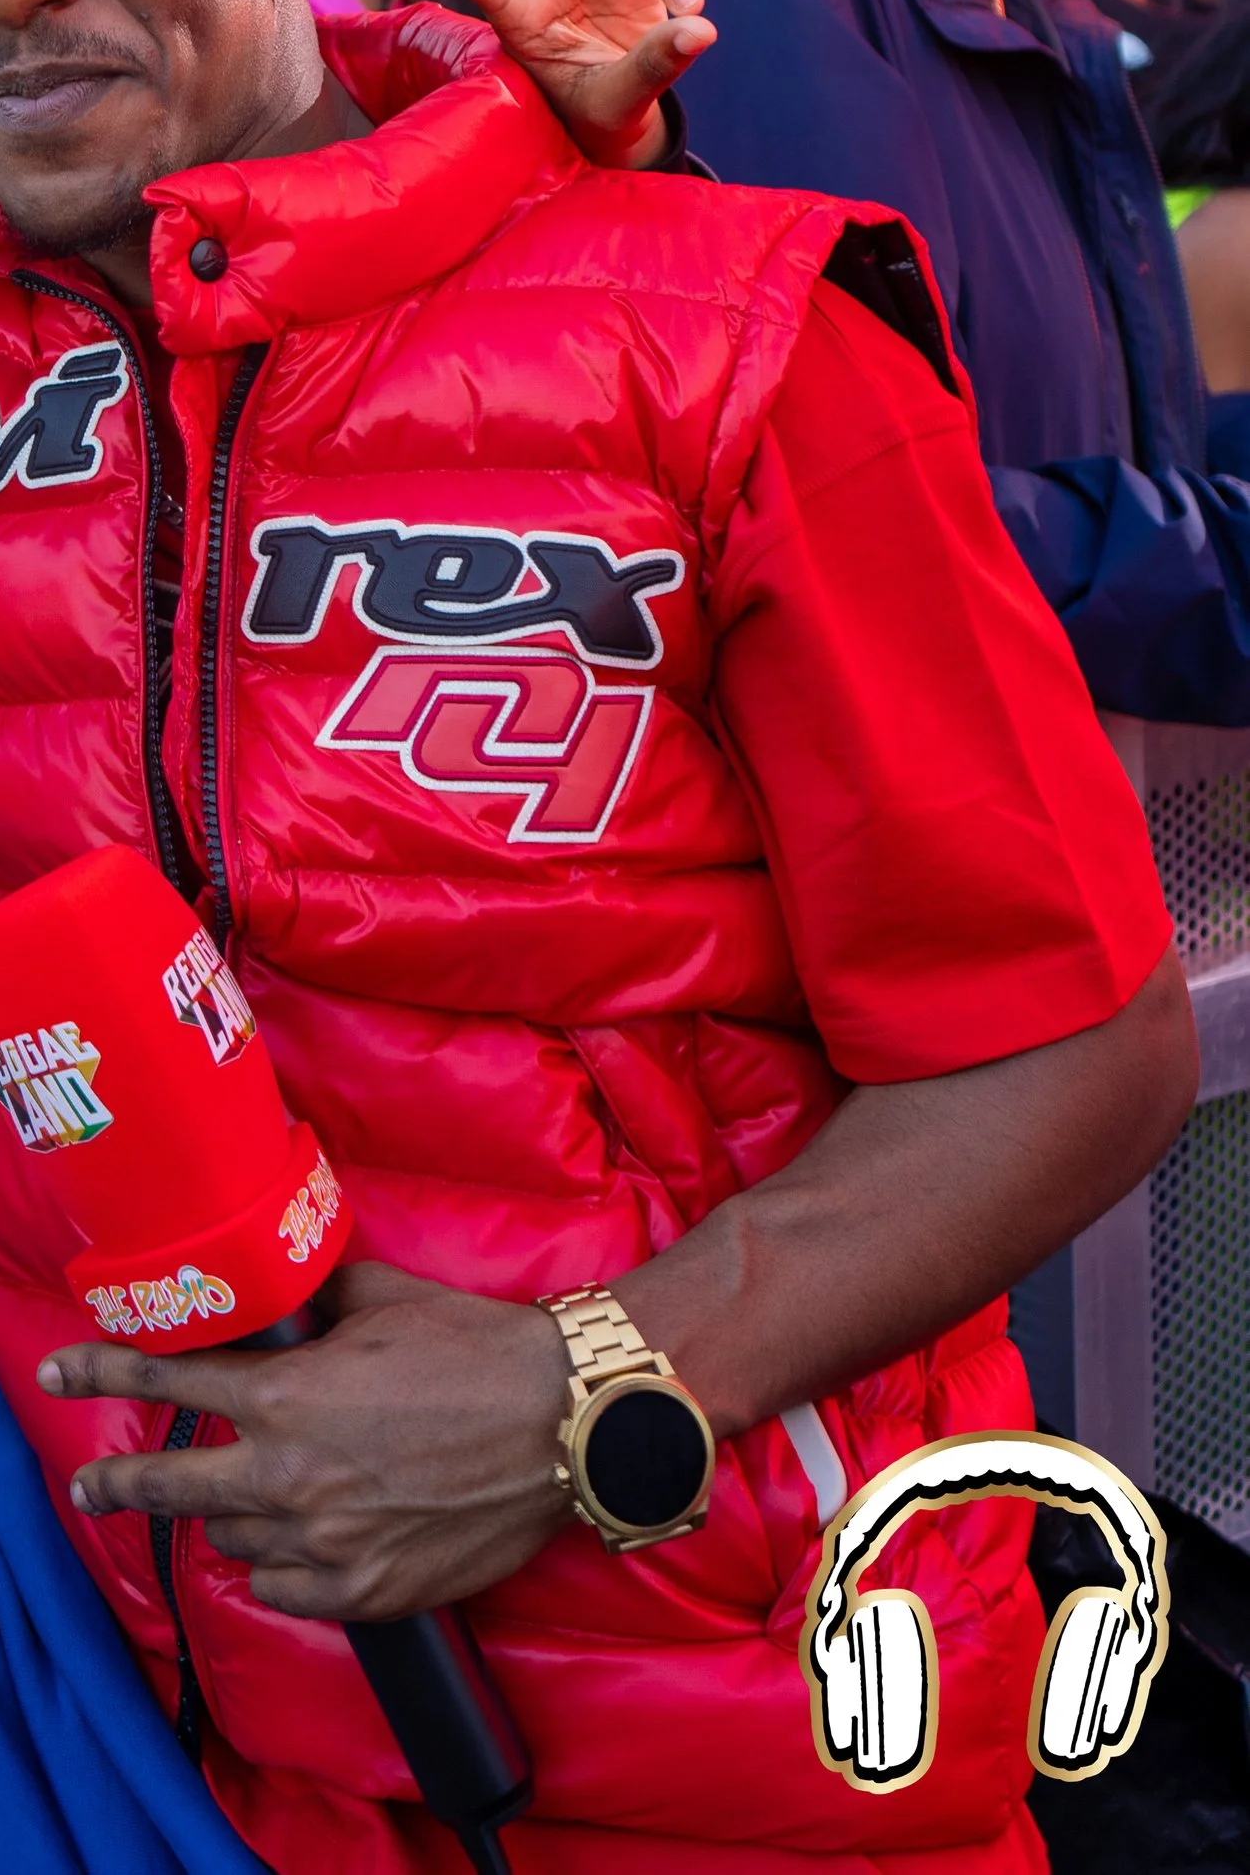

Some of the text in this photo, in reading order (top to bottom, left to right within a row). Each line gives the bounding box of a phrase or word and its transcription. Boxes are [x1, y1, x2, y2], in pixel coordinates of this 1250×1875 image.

[241, 515, 686, 670] rex
[162, 925, 226, 1022] REGGA
[3, 1068, 114, 1149] LAND
[130, 1265, 236, 1333] RADIO
